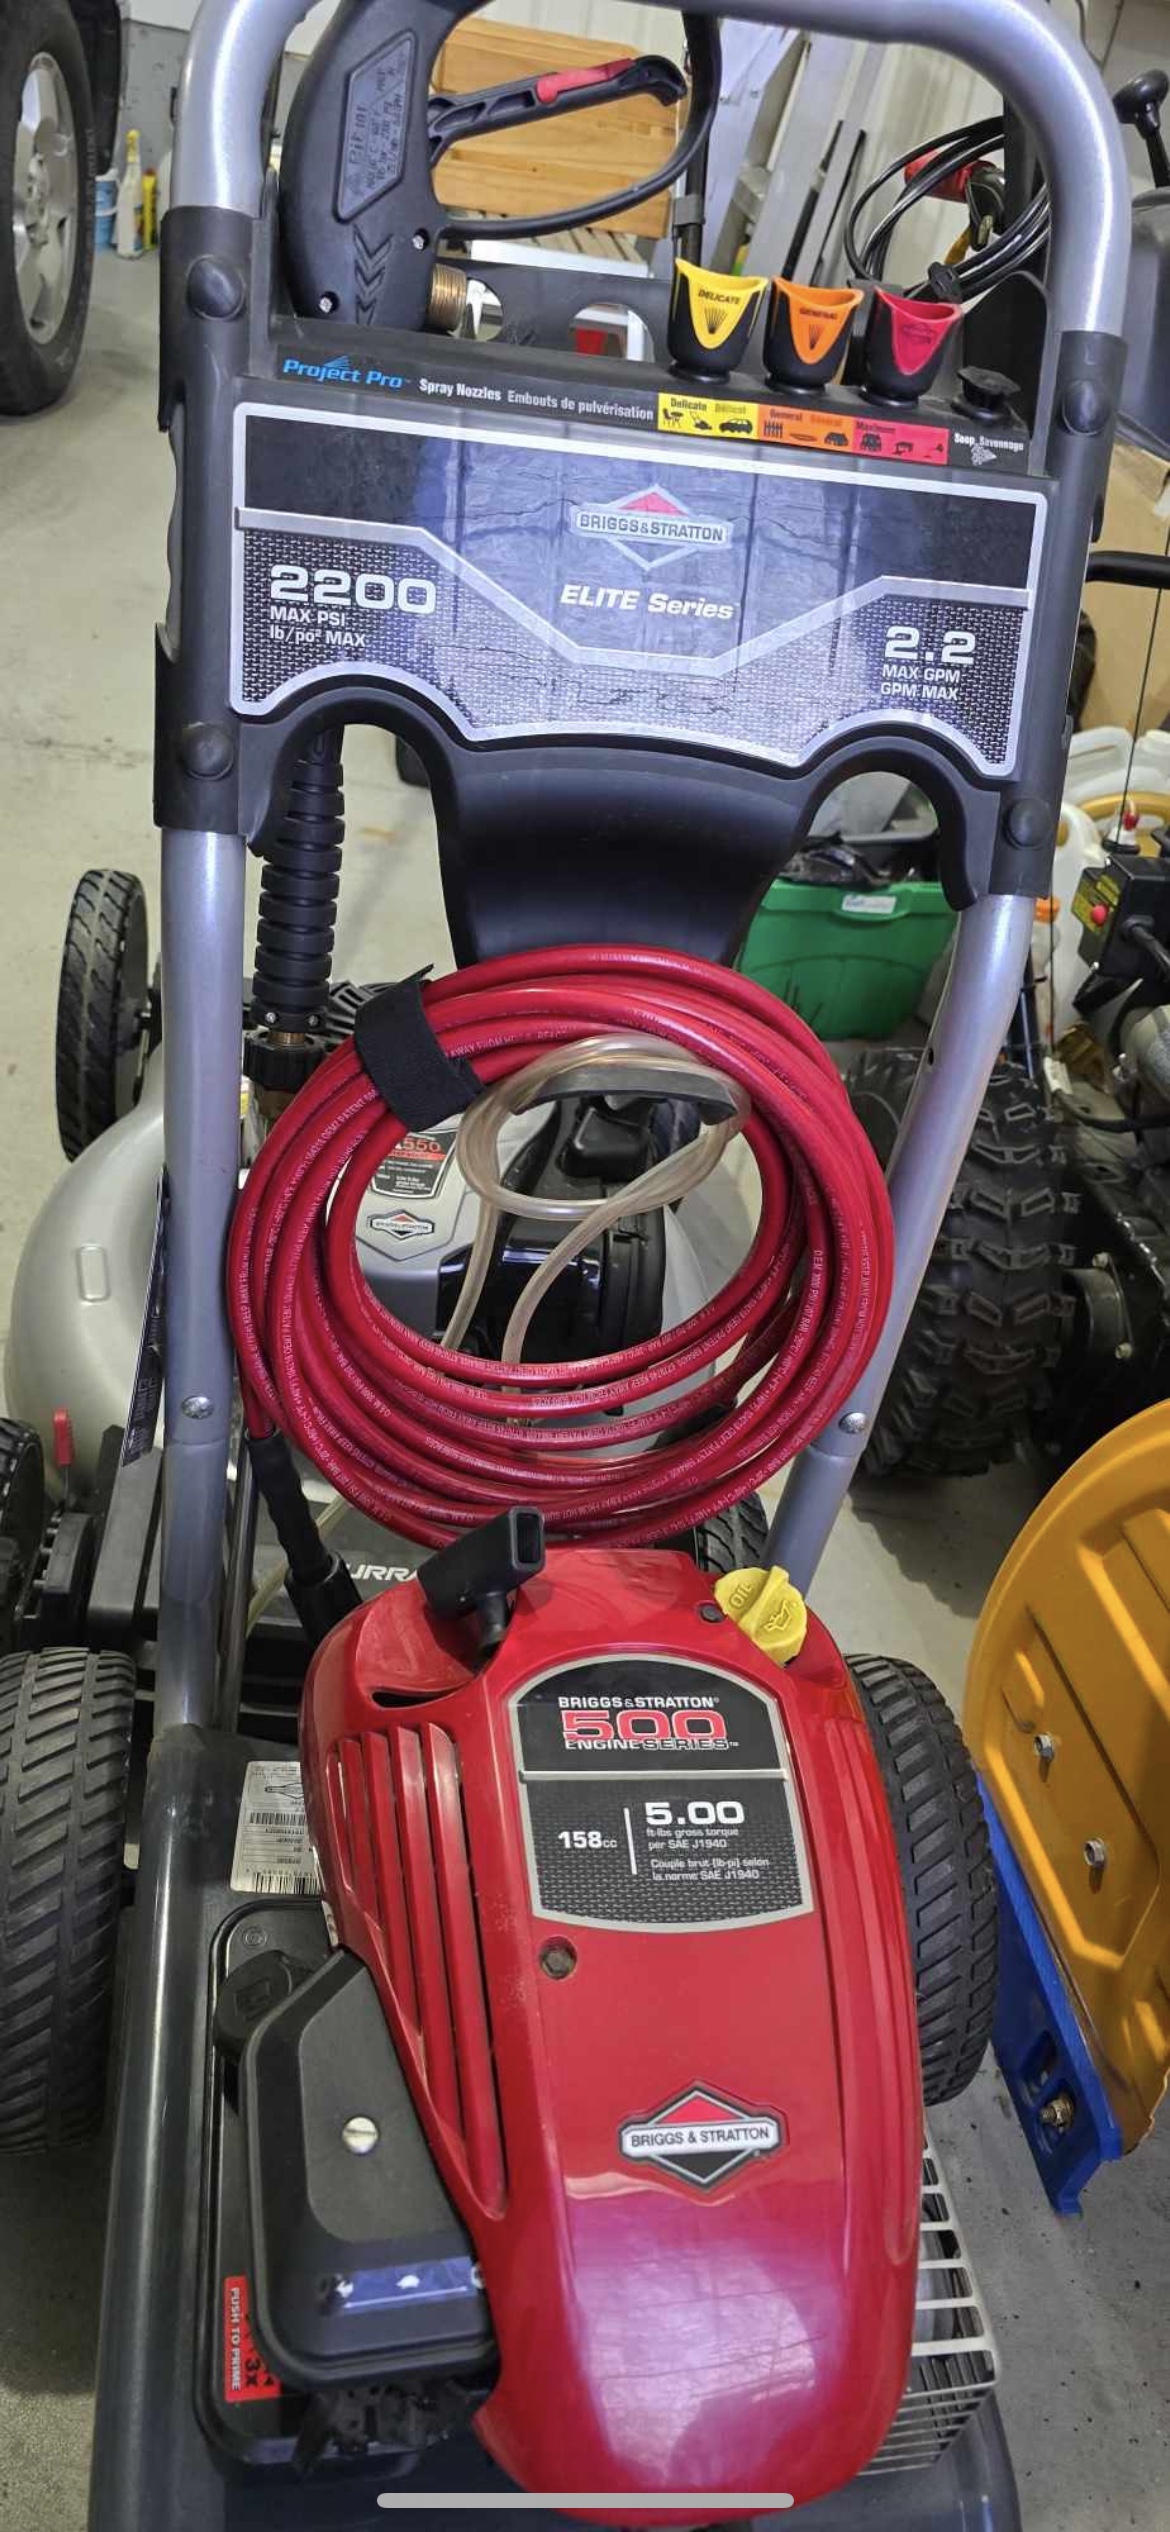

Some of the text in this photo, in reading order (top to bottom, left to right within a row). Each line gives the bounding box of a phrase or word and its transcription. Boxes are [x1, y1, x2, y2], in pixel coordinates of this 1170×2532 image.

[698, 288, 741, 305] DELICATE
[800, 307, 838, 321] GENERAL
[283, 358, 361, 382] Project
[419, 378, 502, 401] Spray Nozzles
[508, 390, 654, 421] Embouts de pulvérisation
[670, 398, 708, 411] Delicate
[770, 408, 803, 421] General
[856, 420, 896, 434] Maximum
[580, 514, 725, 543] BRIGGS&STRATTON
[270, 564, 436, 614] 2200
[561, 584, 734, 620] ELITE Series
[270, 606, 346, 627] MAX PSI
[325, 630, 366, 647] MAX
[884, 626, 976, 665] 2.2
[882, 664, 961, 683] MAX GPM
[880, 682, 959, 700] GPM MAX
[404, 1137, 440, 1152] 550
[729, 1580, 752, 1610] OIL
[562, 1710, 727, 1741] 500
[645, 1801, 745, 1825] 5.00
[674, 1829, 704, 1838] gross
[706, 1828, 738, 1838] torque
[648, 1838, 728, 1851] per SAE J1940
[650, 1859, 686, 1870] Couple
[687, 1858, 711, 1868] brut
[742, 1857, 770, 1866] selon
[652, 1870, 760, 1881] la norme SAE J1940
[631, 2126, 770, 2148] BRIGGS & STRATTON
[231, 2288, 240, 2391] PUSH TO PRIME
